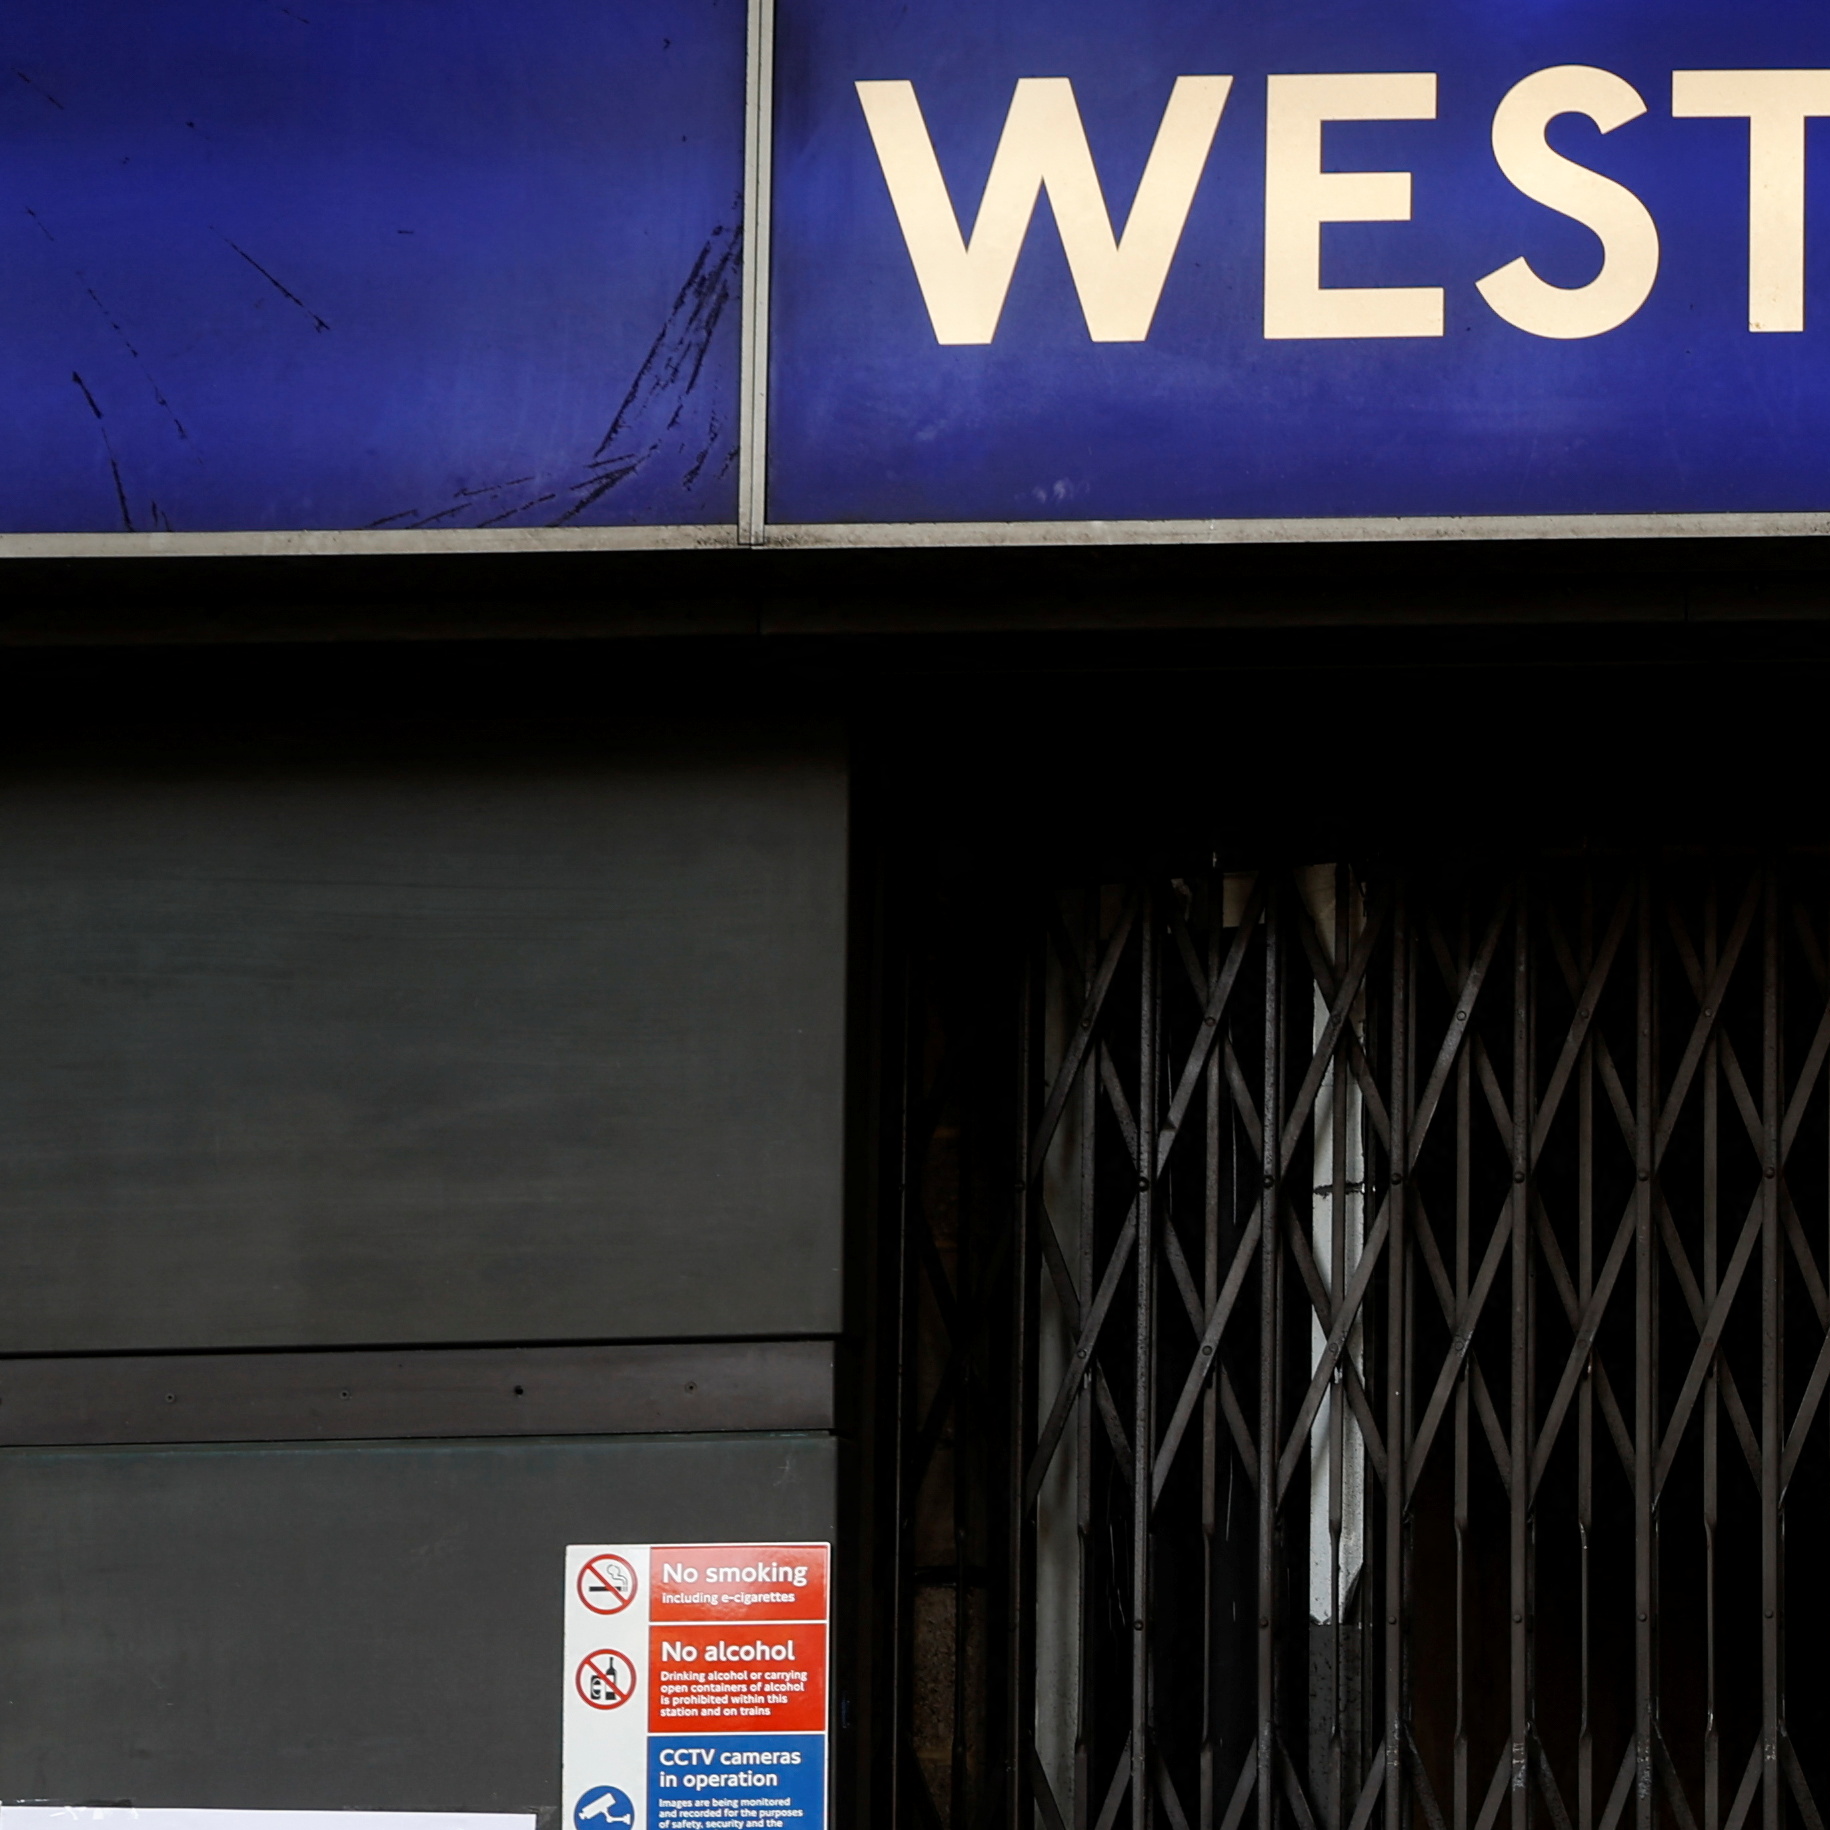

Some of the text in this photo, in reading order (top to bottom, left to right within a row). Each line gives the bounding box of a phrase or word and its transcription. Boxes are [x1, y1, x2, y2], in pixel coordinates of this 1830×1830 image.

[663, 1561, 807, 1586] No smoking
[662, 1591, 795, 1605] including e-cigarettes
[661, 1639, 795, 1662] No alcohol
[660, 1669, 807, 1683] Drinking alcohol or carrying
[660, 1680, 806, 1694] open containers of alcohol
[660, 1692, 788, 1706] is prohibited within this
[660, 1705, 771, 1717] station and on trains
[659, 1748, 801, 1765] CCTV cameras
[659, 1769, 777, 1790] in operation
[658, 1797, 791, 1809] Images are being monitored
[658, 1807, 803, 1820] and recorded for the purposes
